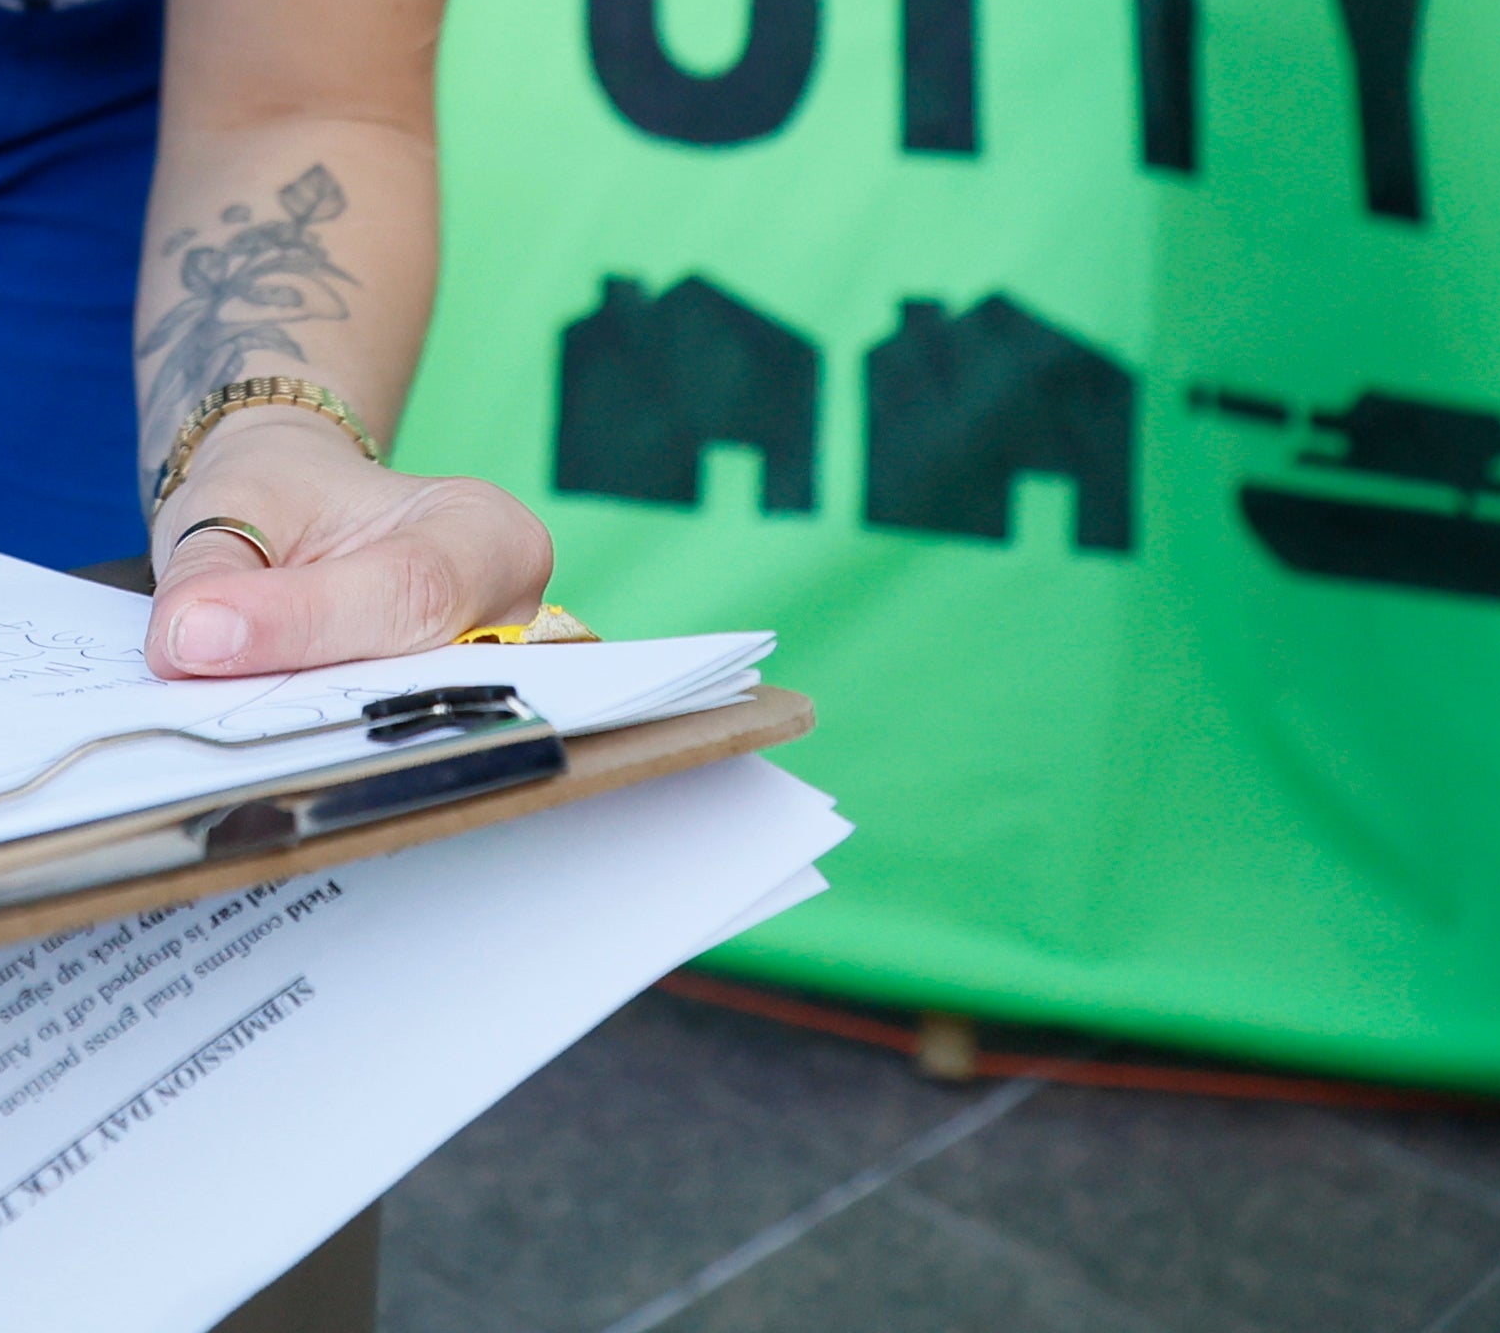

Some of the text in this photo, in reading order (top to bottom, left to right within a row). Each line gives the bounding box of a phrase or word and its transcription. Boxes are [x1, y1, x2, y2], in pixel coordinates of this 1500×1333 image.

[208, 900, 244, 930] car
[284, 879, 343, 923] Field
[86, 923, 134, 966] pick
[182, 923, 210, 944] is
[192, 914, 284, 977] confirms
[55, 958, 87, 986] up
[96, 938, 183, 1006] dropped
[62, 996, 97, 1033] off
[141, 973, 195, 1019] final
[35, 1019, 63, 1043] to
[82, 1005, 141, 1053] gross
[154, 979, 314, 1099] SUBMISSION
[92, 1095, 154, 1143] DAY
[15, 1139, 90, 1196] TICK
